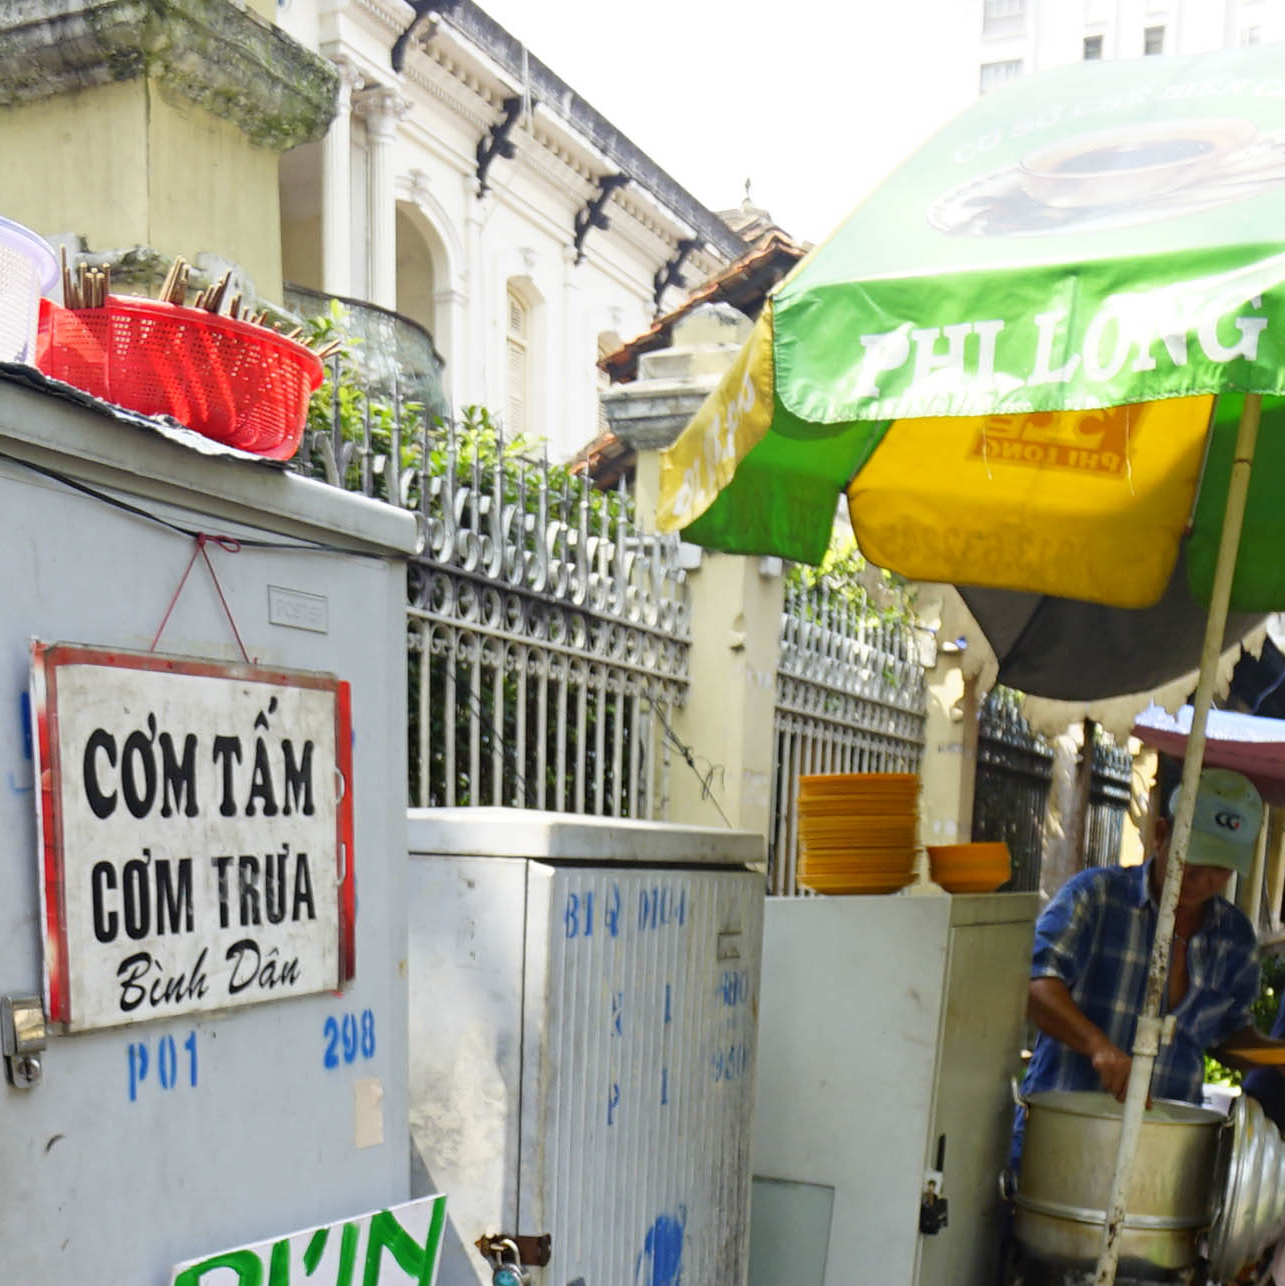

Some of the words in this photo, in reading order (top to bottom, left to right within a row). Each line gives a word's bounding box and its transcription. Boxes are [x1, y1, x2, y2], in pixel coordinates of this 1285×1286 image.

[854, 318, 1005, 399] PHI
[1027, 293, 1269, 387] LONG
[82, 712, 200, 820] CƠM
[212, 696, 315, 818] TẤM
[90, 847, 195, 944] CƠM
[210, 842, 316, 930] TRƯA
[115, 946, 210, 1013] Bình
[224, 937, 302, 995] Dân
[128, 1030, 199, 1102] P01
[322, 1008, 377, 1071] 298
